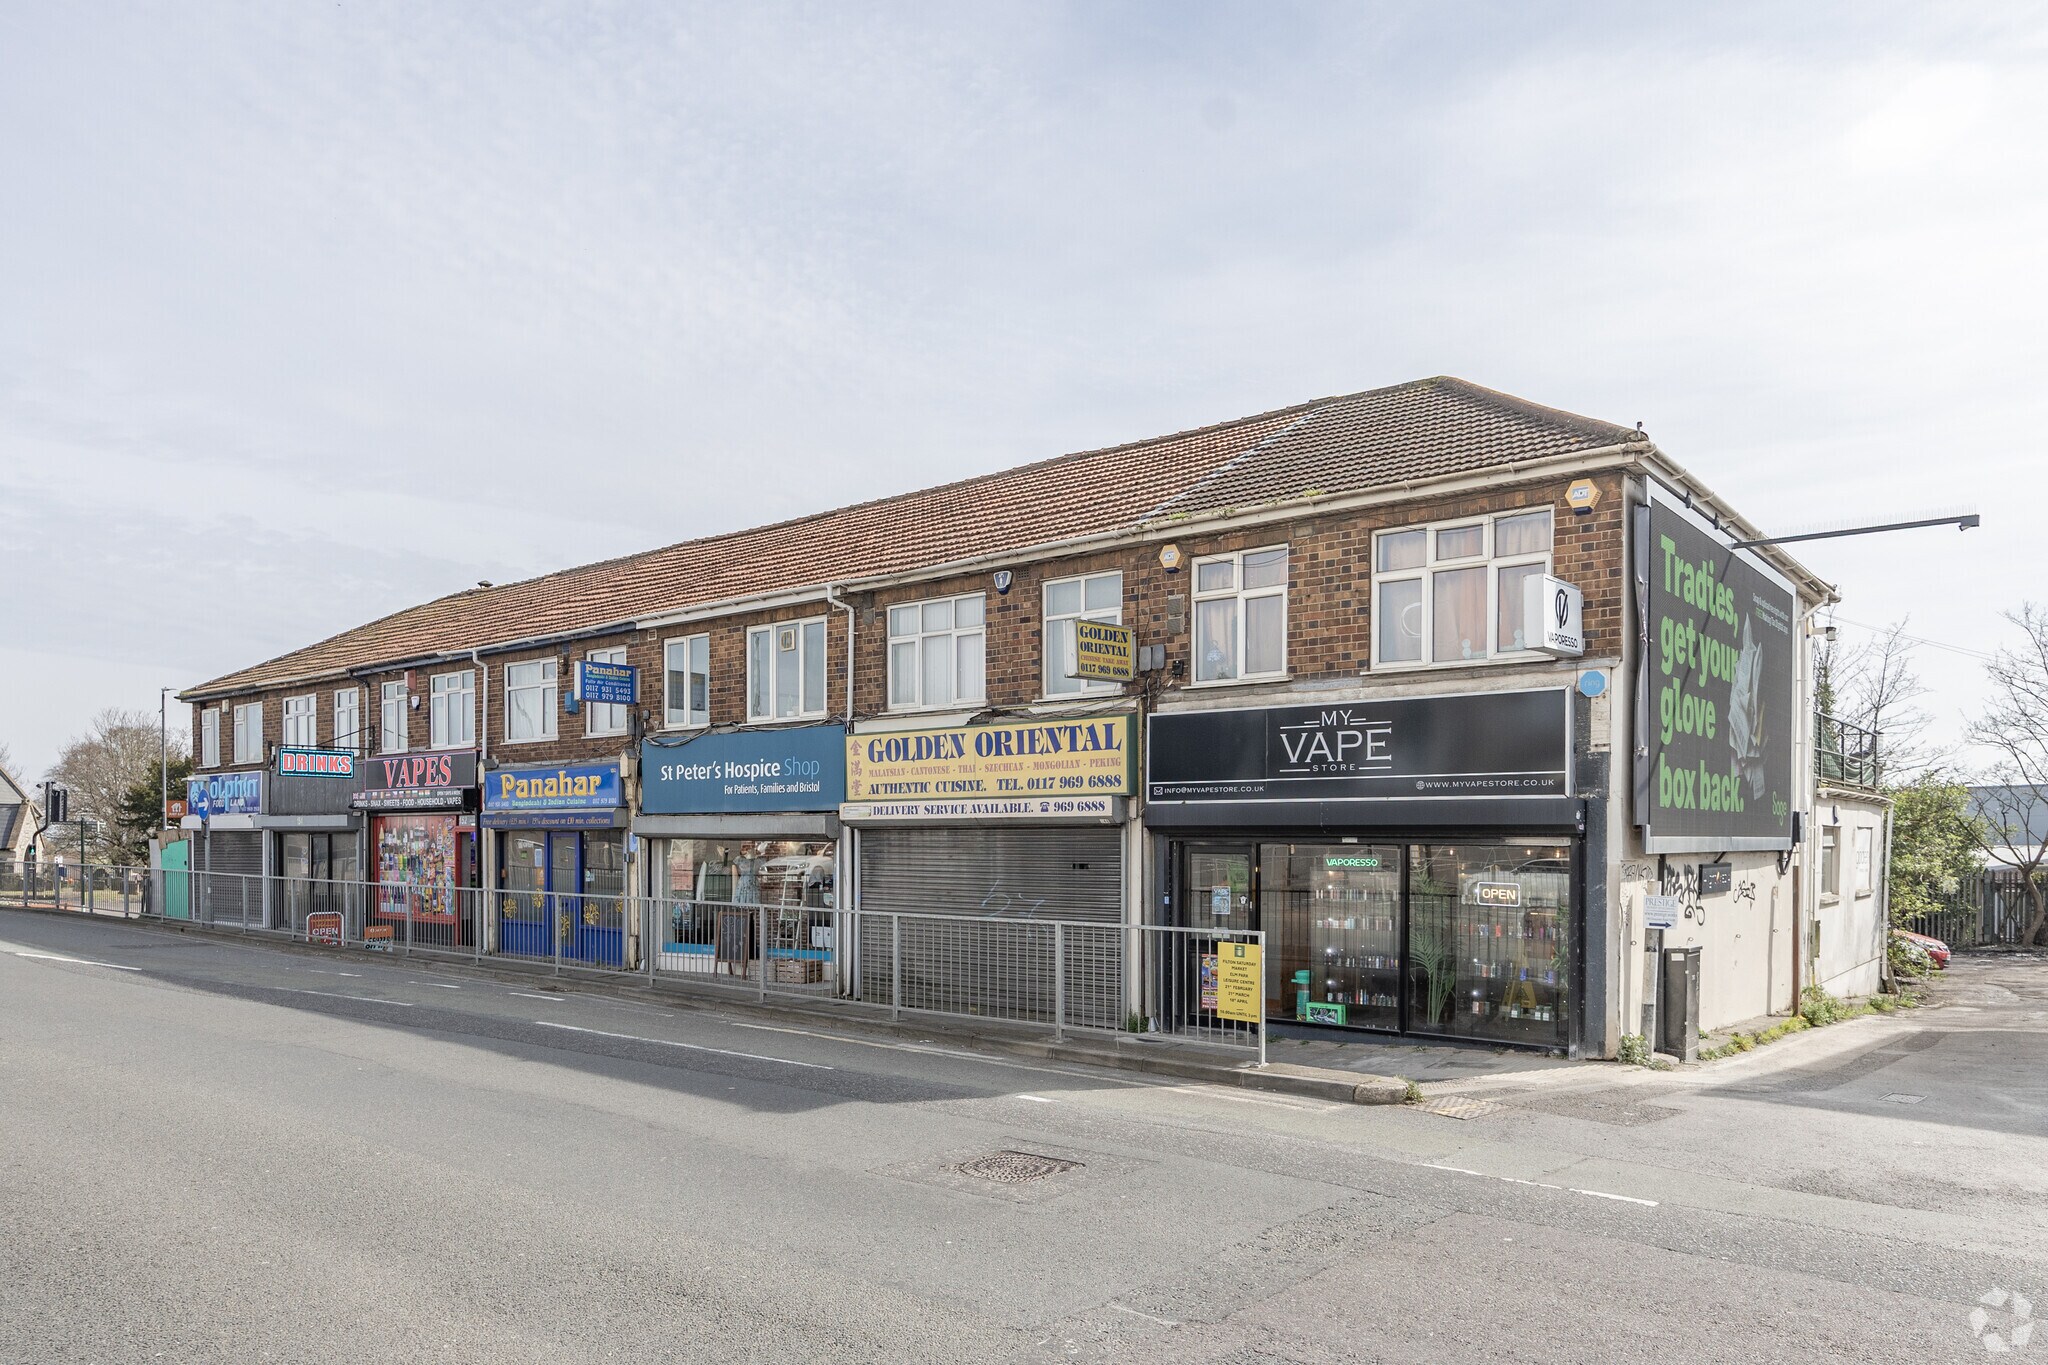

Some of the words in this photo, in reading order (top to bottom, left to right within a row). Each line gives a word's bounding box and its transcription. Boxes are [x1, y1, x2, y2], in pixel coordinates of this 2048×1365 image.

[1573, 489, 1588, 498] ADT
[1661, 534, 1739, 639] Tradies,
[1080, 625, 1128, 643] GOLDEN
[1547, 631, 1578, 649] VAPORESSO
[1080, 641, 1129, 657] ORIENTAL
[1661, 615, 1696, 675] get
[1699, 633, 1740, 688] your
[585, 664, 632, 677] Panahar
[1080, 663, 1096, 672] 0117
[1098, 665, 1111, 674] 969
[1113, 667, 1129, 676] 6888
[1585, 679, 1600, 687] ring
[615, 687, 631, 695] 5493
[616, 694, 631, 702] 8100
[1321, 709, 1353, 726] MY
[1660, 677, 1716, 745] glove
[868, 732, 967, 763] GOLDEN
[974, 723, 1122, 757] ORIENTAL
[1280, 727, 1392, 763] VAPE
[282, 753, 352, 774] DRINKS
[661, 765, 673, 781] St
[676, 761, 721, 781] Peter's
[724, 758, 780, 781] Hospice
[784, 756, 820, 780] Shop
[869, 768, 906, 778] MALAYSIAN
[911, 766, 950, 775] CANTONESE
[958, 764, 976, 773] THAI
[984, 762, 1024, 772] SZECHUAN
[1033, 759, 1081, 770] MONGOLIAN
[1090, 757, 1121, 767] PEKING
[1312, 763, 1356, 772] STORE
[383, 755, 452, 788] VAPES
[500, 771, 602, 799] Panahar
[724, 784, 734, 794] For
[734, 783, 759, 796] Patients,
[760, 782, 786, 793] Families
[786, 782, 798, 792] and
[799, 781, 820, 792] Bristol
[868, 782, 931, 795] AUTHENTIC
[935, 780, 987, 793] CUISINE.
[996, 778, 1024, 791] TEL.
[1027, 776, 1056, 790] 0117
[1059, 776, 1084, 788] 969
[1088, 774, 1122, 788] 6888
[1164, 785, 1265, 794] INFO@MYVAPESTORE.CO.UK
[1425, 779, 1555, 788] WWW.MYVAPESTORE.CO.UK
[1660, 752, 1696, 809] box
[1700, 759, 1744, 813] back.
[402, 798, 415, 806] FOOD
[446, 797, 462, 805] VAPES
[873, 805, 920, 816] DELIVERY
[924, 804, 967, 815] SERVICE
[970, 802, 1034, 814] AVAILABLE.
[1053, 801, 1074, 812] 969
[1077, 801, 1106, 812] 6888
[1326, 858, 1378, 867] VAPORESSO
[1482, 888, 1516, 900] OPEN
[1645, 897, 1676, 907] PRESTIGE
[312, 927, 339, 936] OPEN
